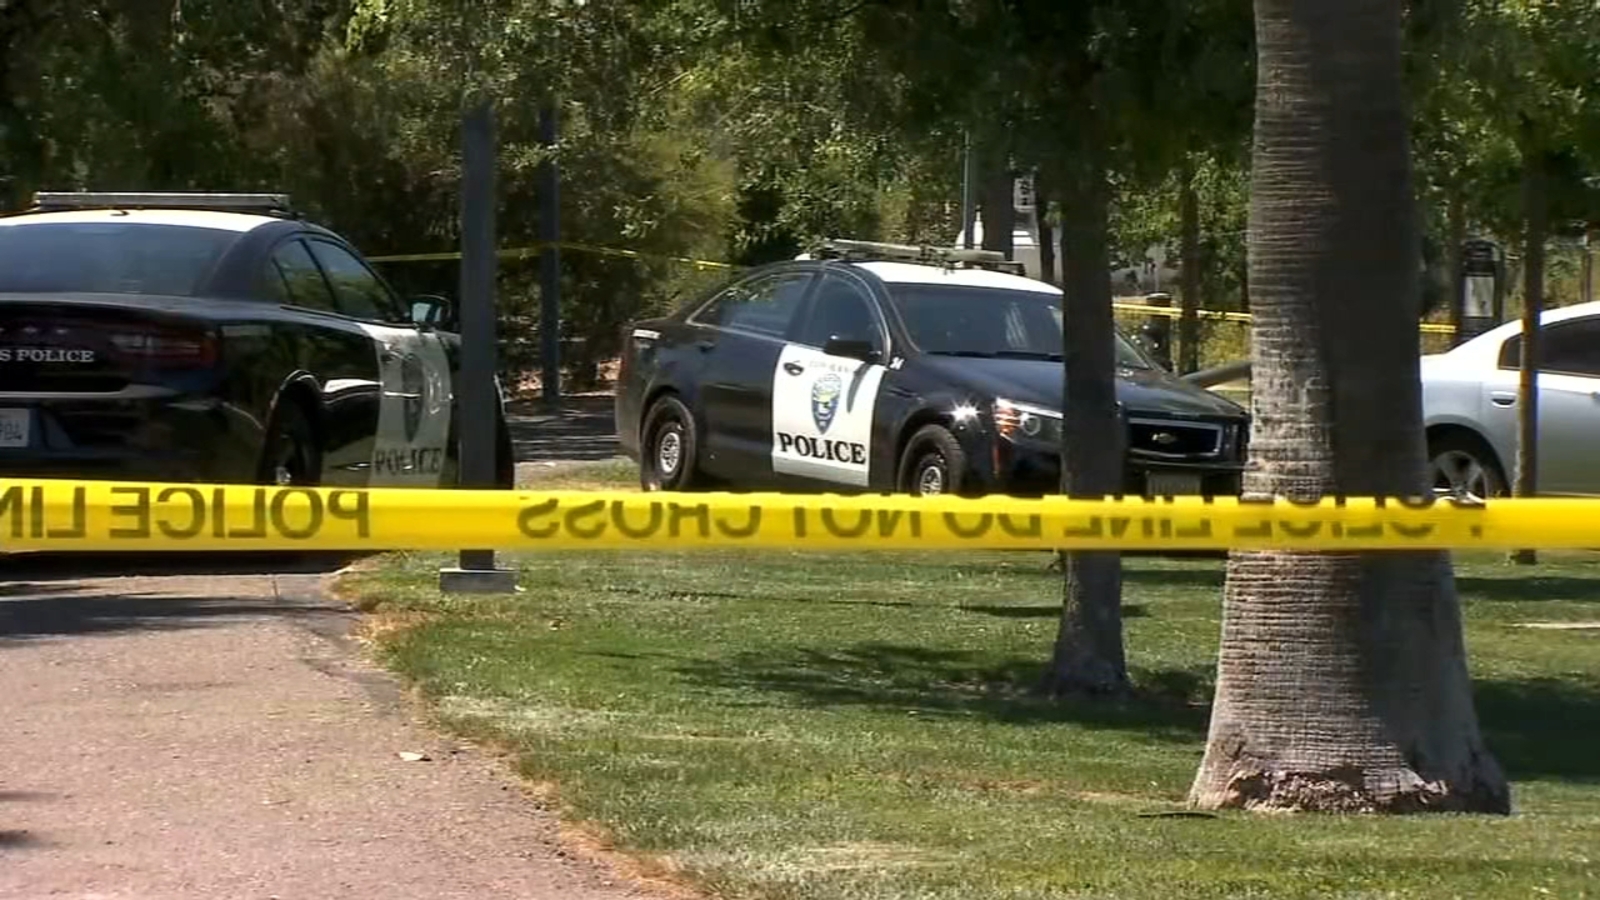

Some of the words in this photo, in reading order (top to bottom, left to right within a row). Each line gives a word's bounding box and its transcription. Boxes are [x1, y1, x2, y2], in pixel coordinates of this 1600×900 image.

[16, 349, 95, 363] POLICE
[374, 448, 441, 476] POLICE
[777, 432, 866, 465] POLICE
